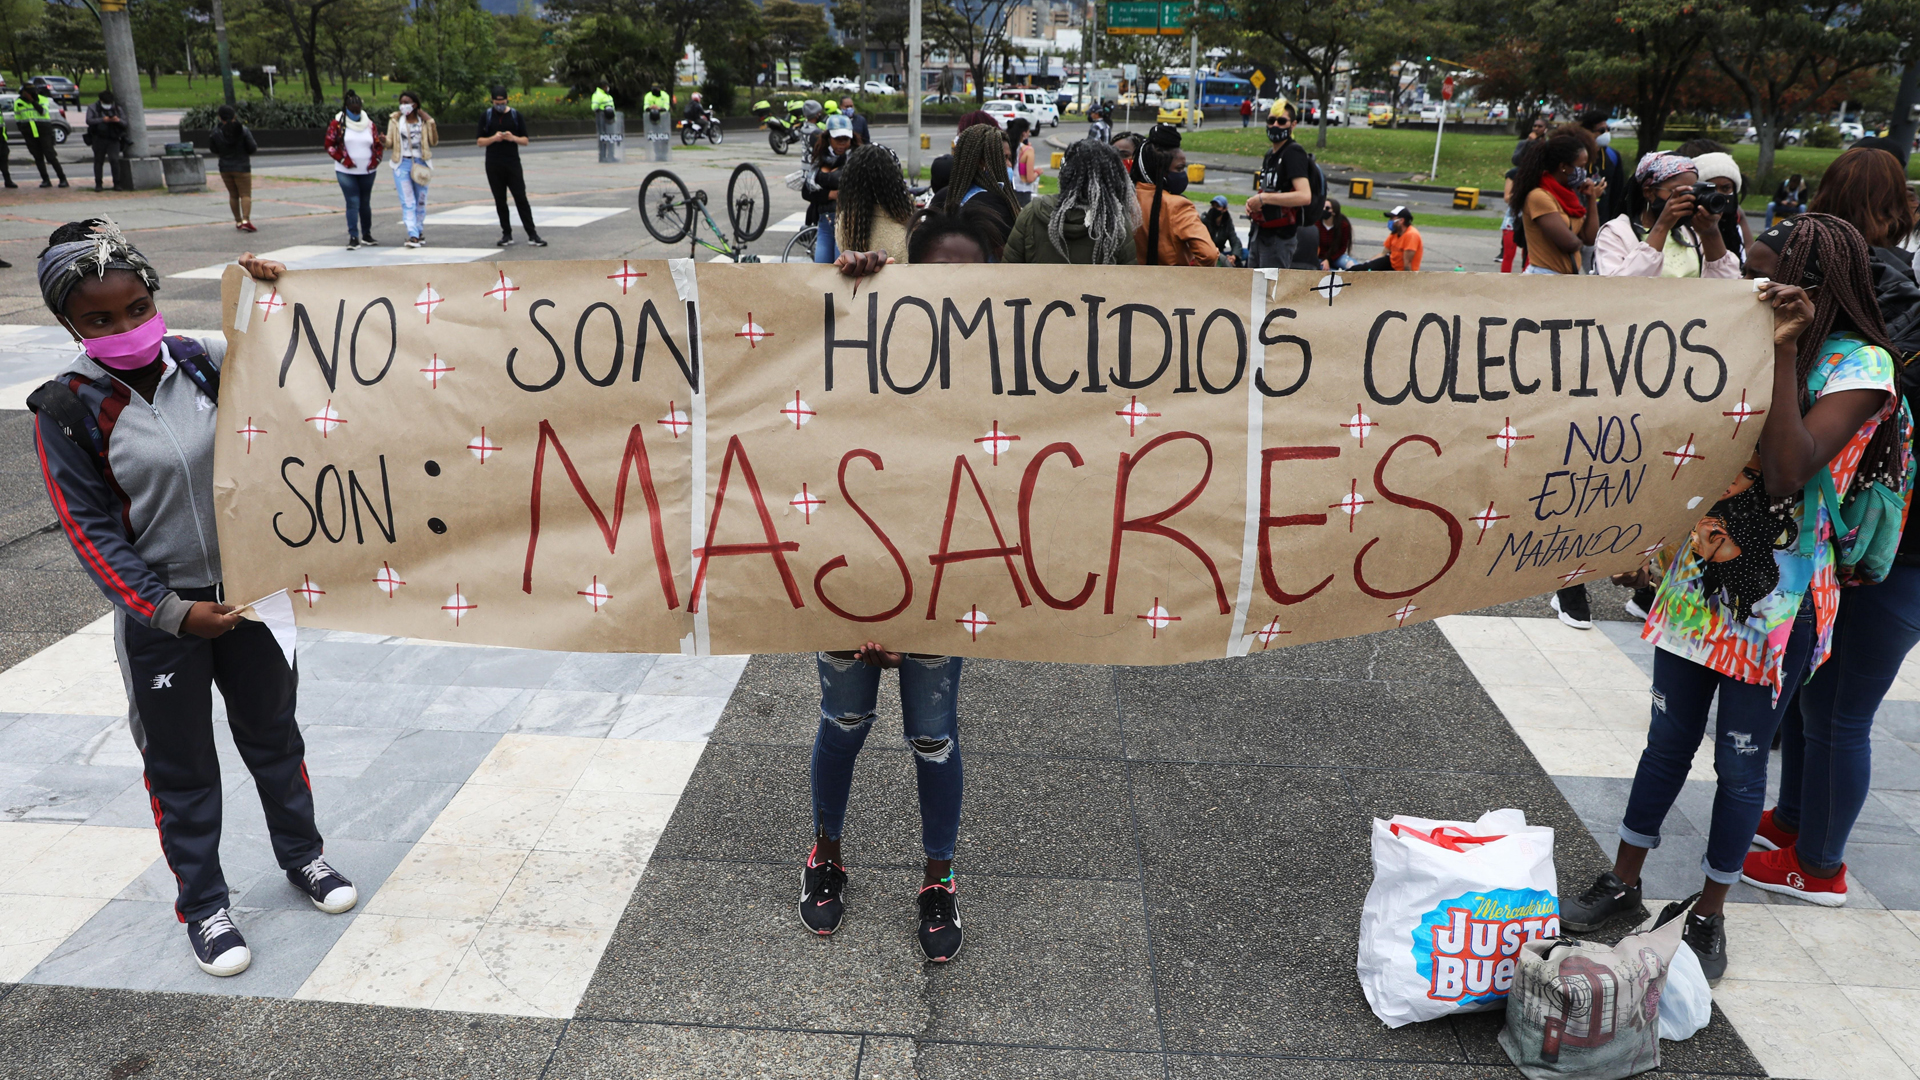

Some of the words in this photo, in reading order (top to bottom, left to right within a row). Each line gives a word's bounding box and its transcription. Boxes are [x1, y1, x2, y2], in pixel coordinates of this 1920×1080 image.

[279, 296, 398, 394] NO
[505, 298, 700, 394] SON
[823, 292, 1312, 398] HOMICIDIOS
[1363, 309, 1728, 405] COLECTIVOS
[1563, 413, 1643, 465] NOS
[522, 418, 1463, 622] MASACRES
[1529, 464, 1646, 521] ESTAN
[1486, 523, 1643, 577] MATANDO
[1474, 895, 1555, 920] Mercadería
